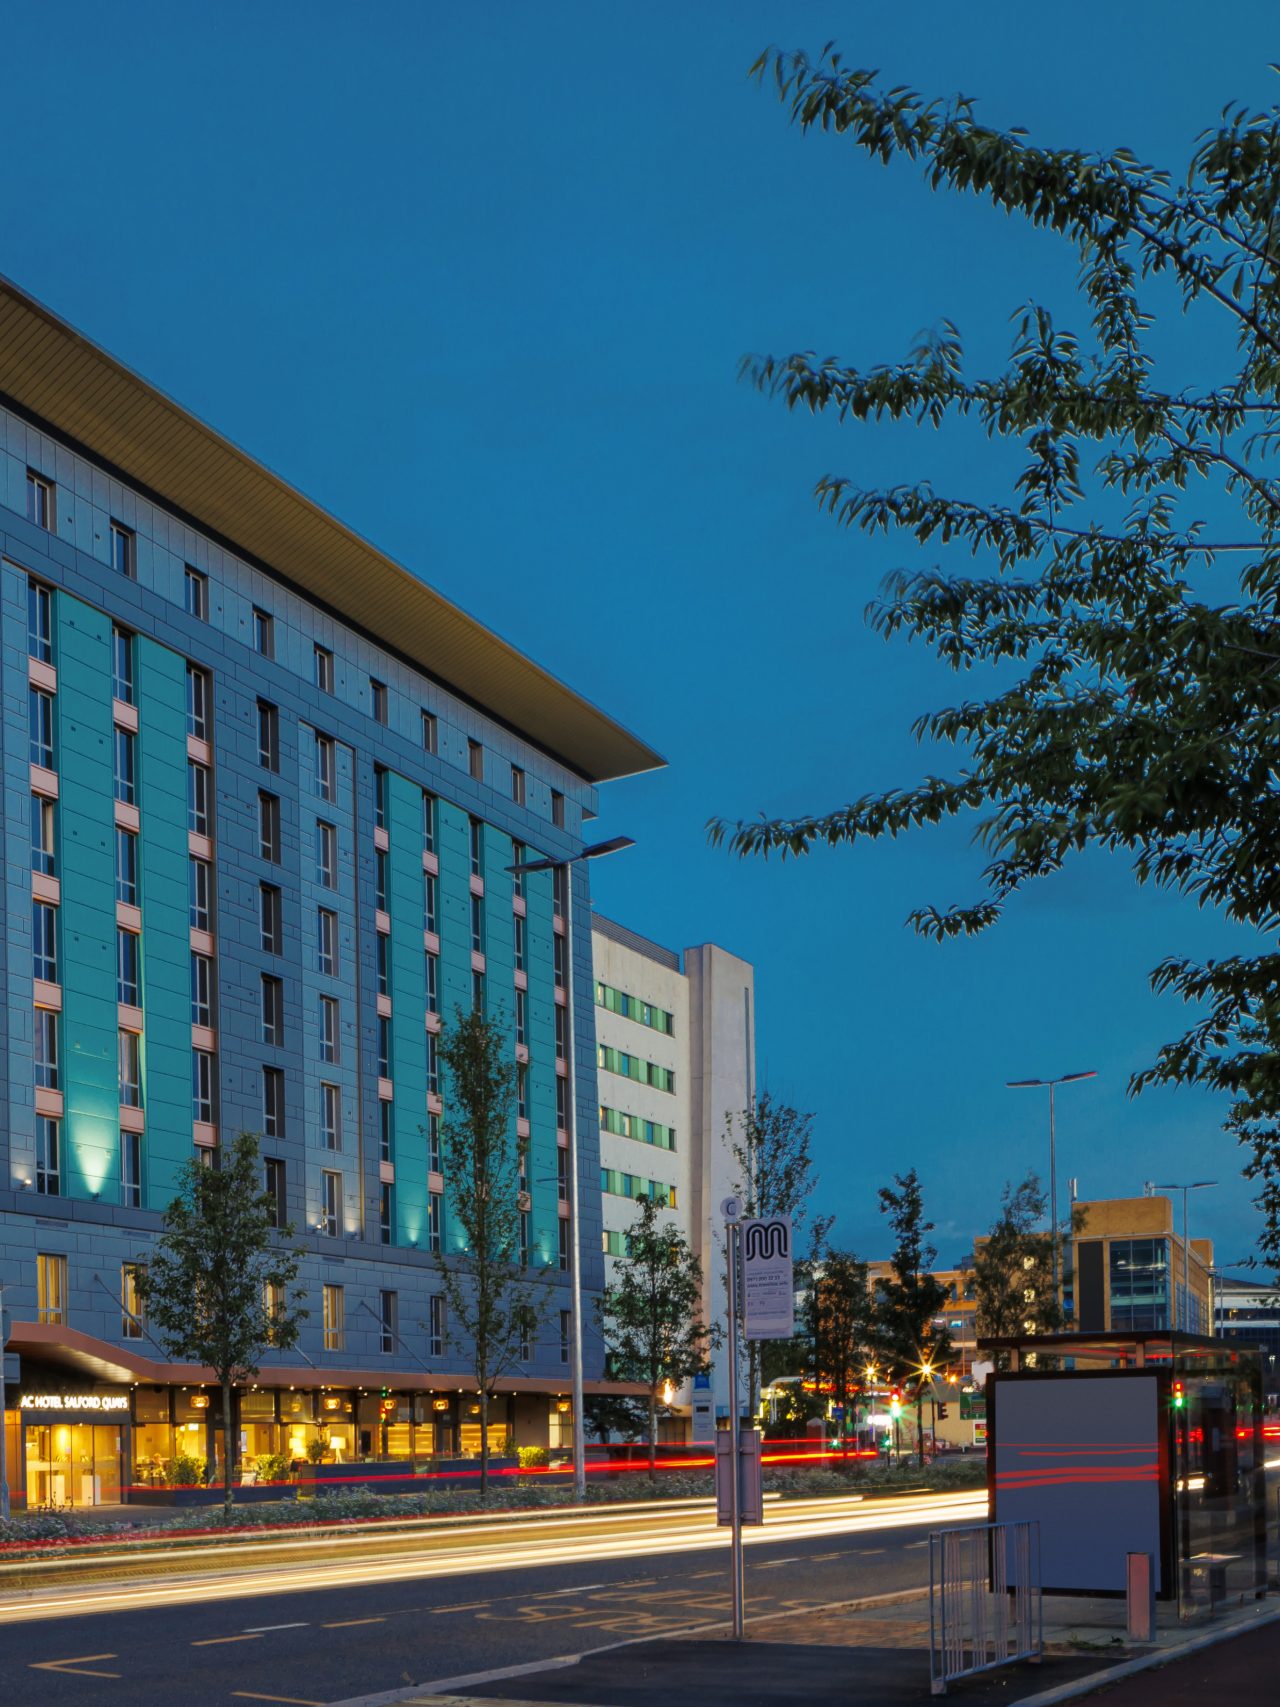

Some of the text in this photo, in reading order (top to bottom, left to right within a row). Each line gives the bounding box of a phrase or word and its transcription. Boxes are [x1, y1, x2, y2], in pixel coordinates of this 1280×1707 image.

[726, 1202, 736, 1216] C
[21, 1396, 128, 1410] AC HOTEL SALFORD QUAYS
